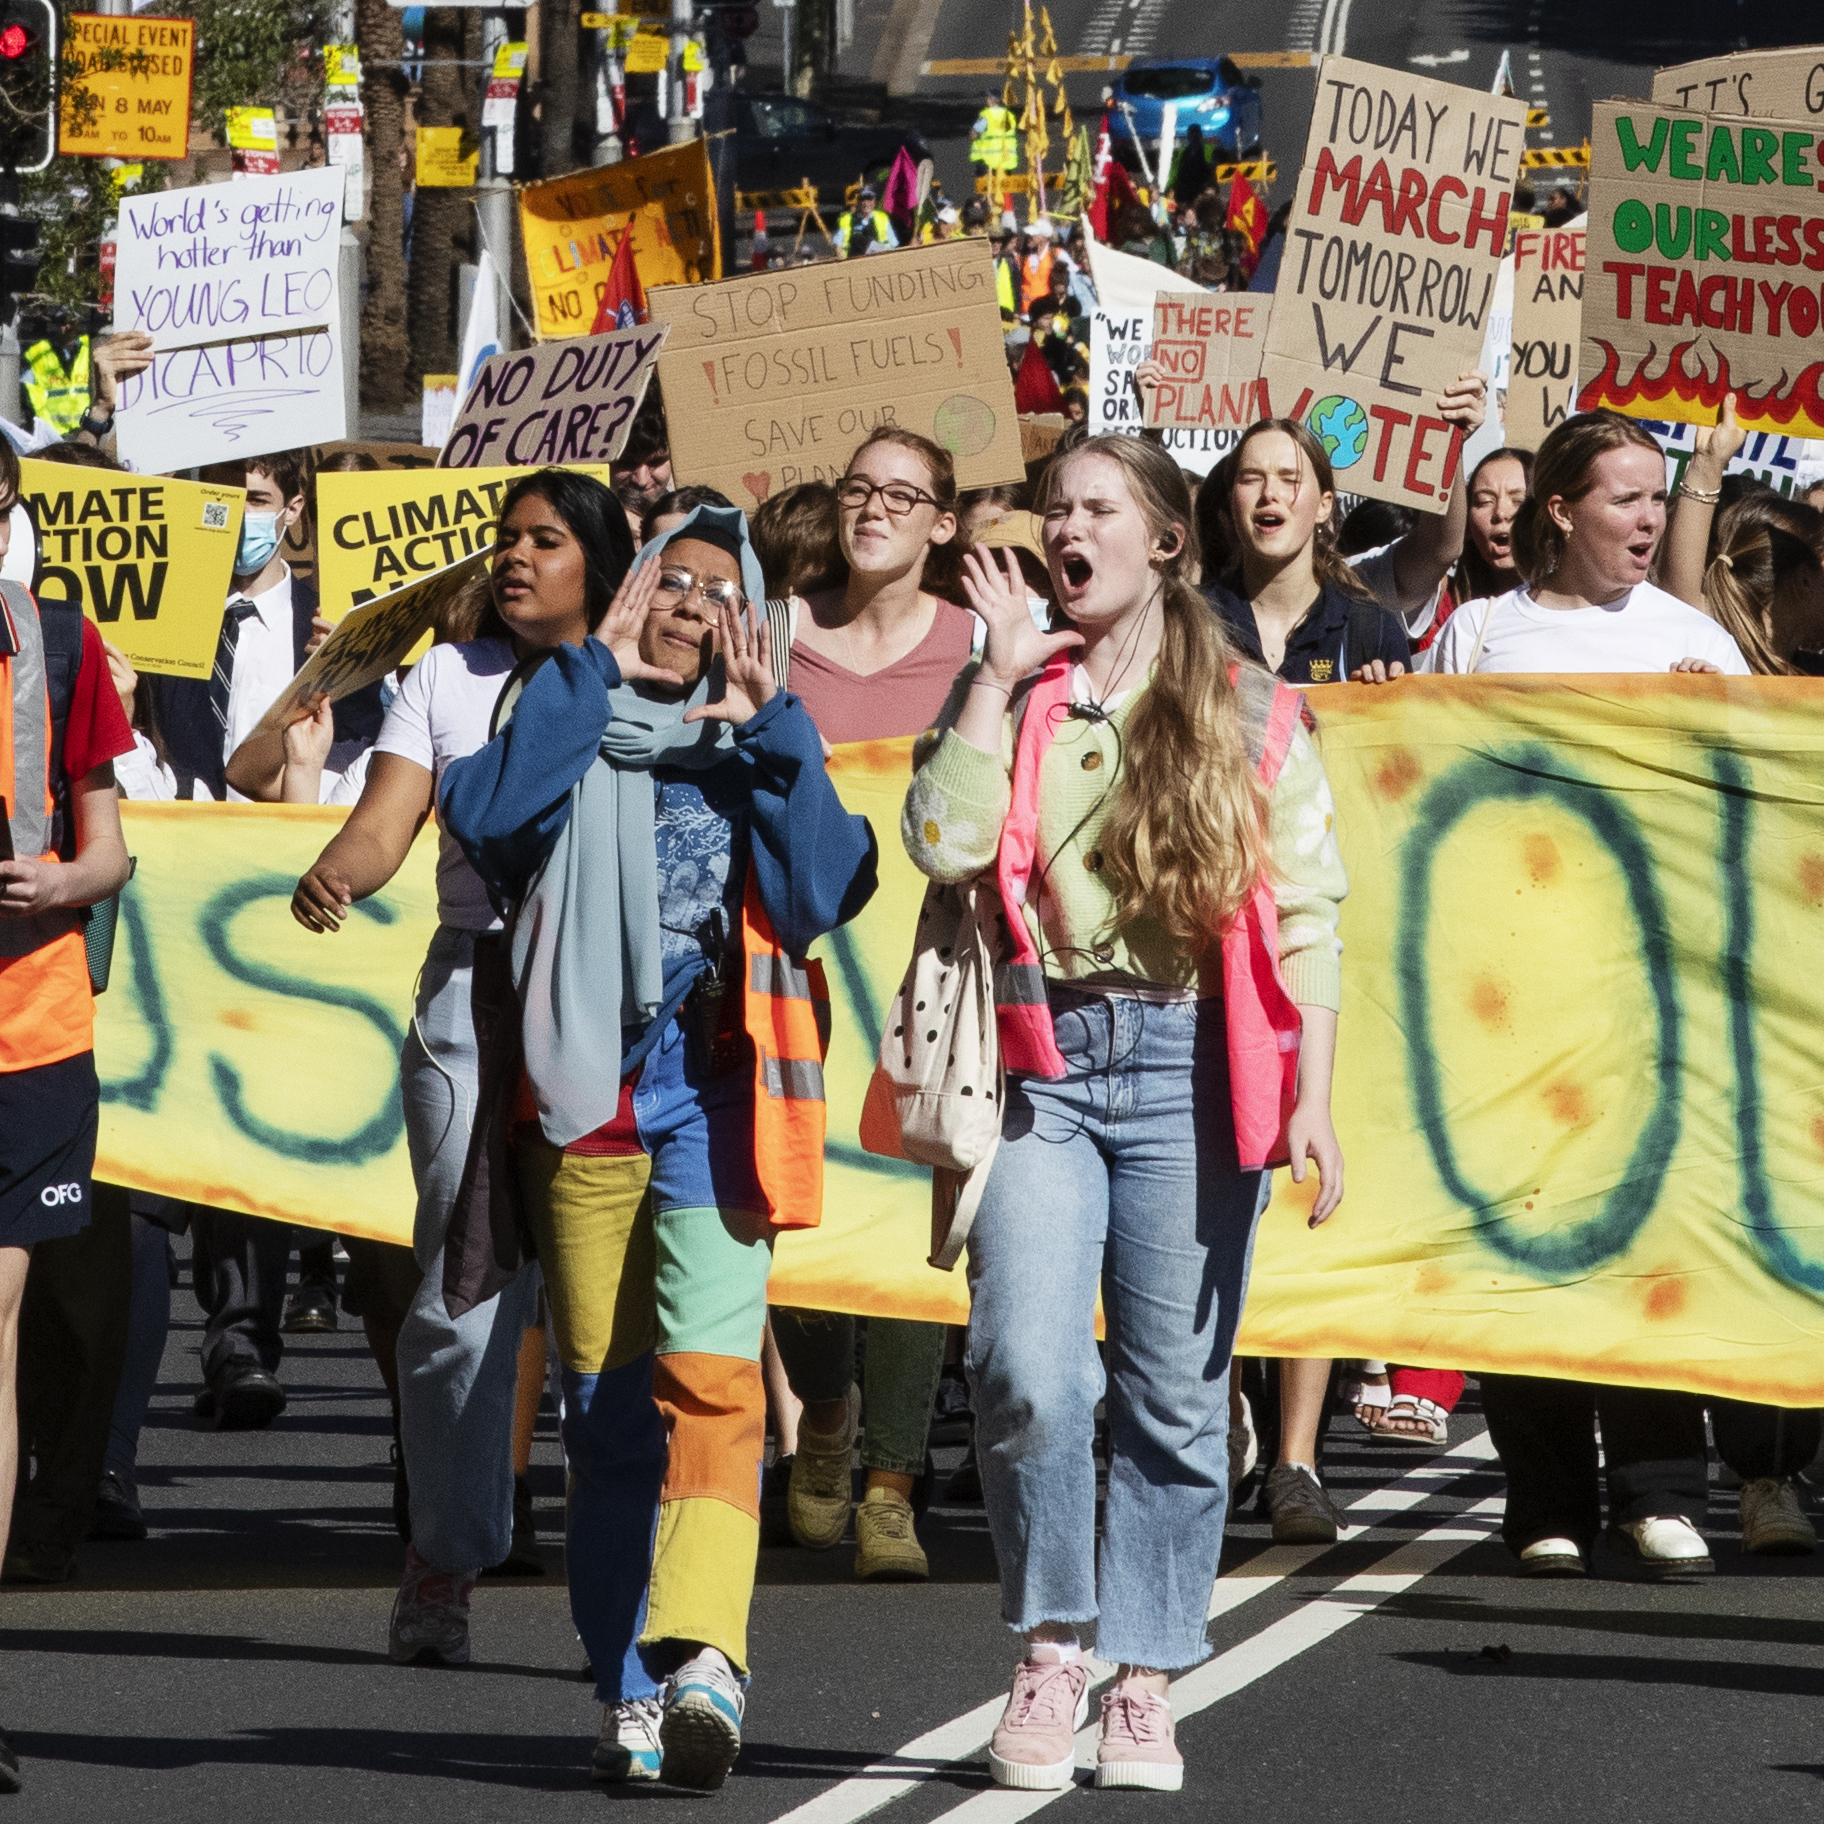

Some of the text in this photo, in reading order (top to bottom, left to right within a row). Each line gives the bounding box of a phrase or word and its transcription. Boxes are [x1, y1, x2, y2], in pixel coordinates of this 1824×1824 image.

[138, 25, 189, 48] EVENT
[115, 97, 173, 116] 8 MAY
[1675, 72, 1753, 117] IT'S
[111, 125, 172, 144] TO 10AM
[1325, 79, 1520, 183] TODAY WE
[1616, 115, 1703, 182] WE
[1706, 126, 1814, 187] ARE
[129, 186, 336, 242] World's getting
[1306, 146, 1512, 258] MARCH
[157, 229, 302, 271] hotter than
[1612, 198, 1733, 262] OUR
[131, 267, 334, 333] YOUNG LEO
[691, 263, 984, 338] STOP FUNDING
[1294, 228, 1493, 331] TOMORROW
[1603, 261, 1755, 335] TEACH
[547, 290, 583, 325] NO
[1155, 302, 1255, 338] THERE
[115, 329, 334, 413] DICAPRIO
[465, 332, 663, 414] NO DUTY
[1159, 348, 1200, 375] NO
[1311, 301, 1435, 397] WE
[1511, 340, 1571, 380] YOU
[439, 417, 507, 468] OF
[505, 395, 636, 464] CARE?
[744, 404, 902, 457] SAVE OUR
[1102, 398, 1130, 421] OR
[200, 488, 241, 500] Order yours
[130, 652, 205, 669] Conservation Council
[40, 1182, 83, 1207] OFG
